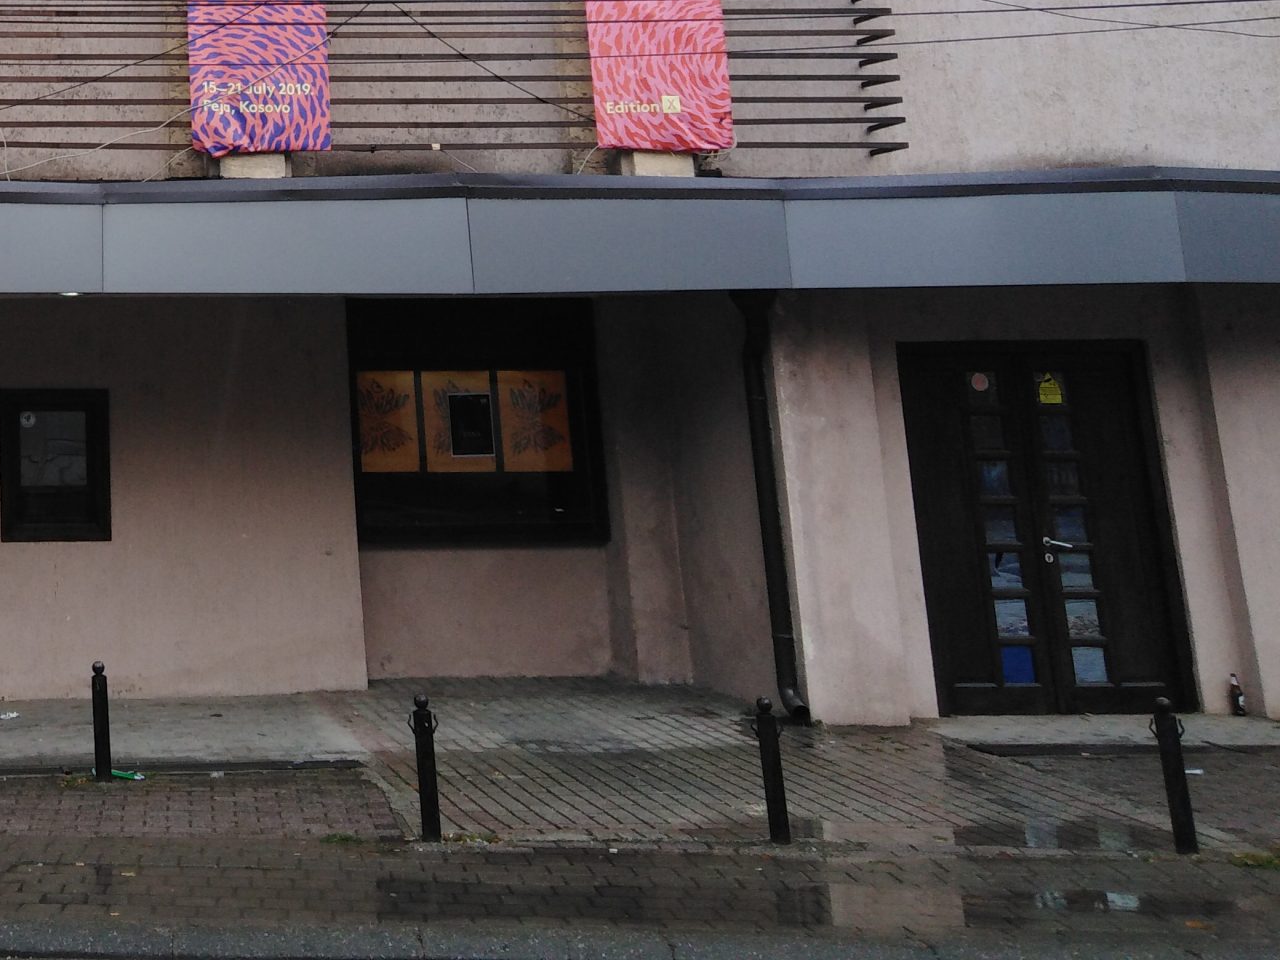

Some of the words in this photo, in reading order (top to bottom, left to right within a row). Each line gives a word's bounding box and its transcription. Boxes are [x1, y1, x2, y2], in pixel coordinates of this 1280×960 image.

[246, 83, 276, 98] July
[239, 100, 291, 114] Kosovo
[606, 99, 660, 114] Edition
